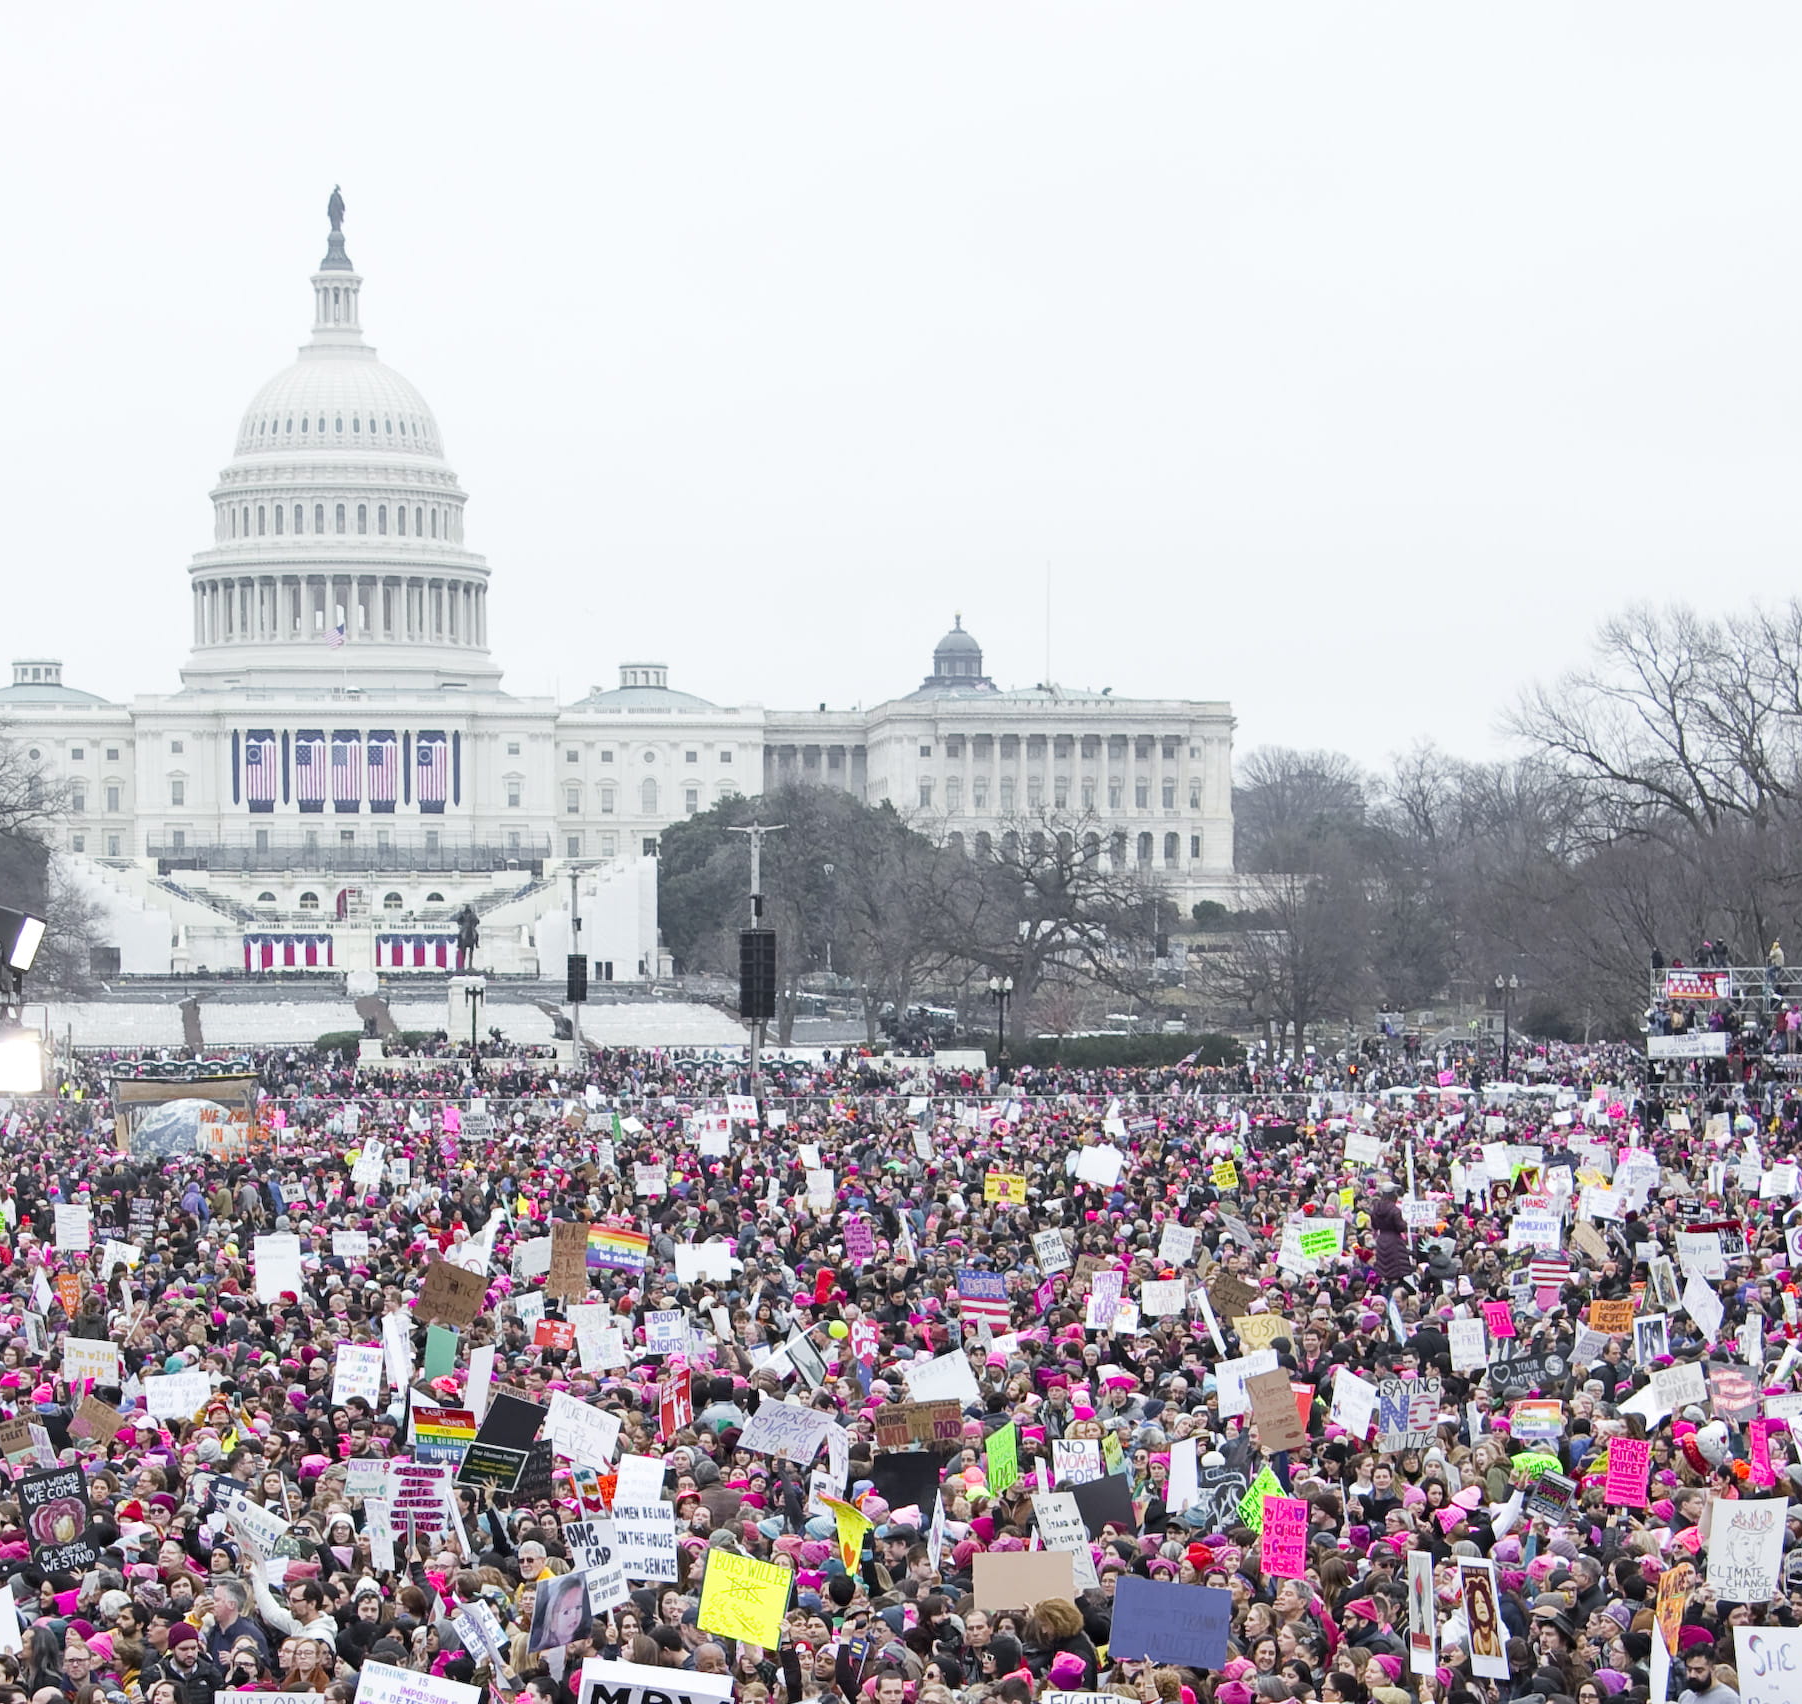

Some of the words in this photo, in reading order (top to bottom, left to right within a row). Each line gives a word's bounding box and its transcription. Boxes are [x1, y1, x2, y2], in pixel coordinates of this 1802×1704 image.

[23, 1479, 51, 1493] FROM
[52, 1471, 80, 1488] WOMEN
[26, 1491, 45, 1505] WE
[46, 1482, 81, 1499] COME
[41, 1550, 56, 1563] BY
[53, 1542, 89, 1559] WOMEN
[41, 1558, 61, 1573] WE
[61, 1549, 96, 1569] STAND
